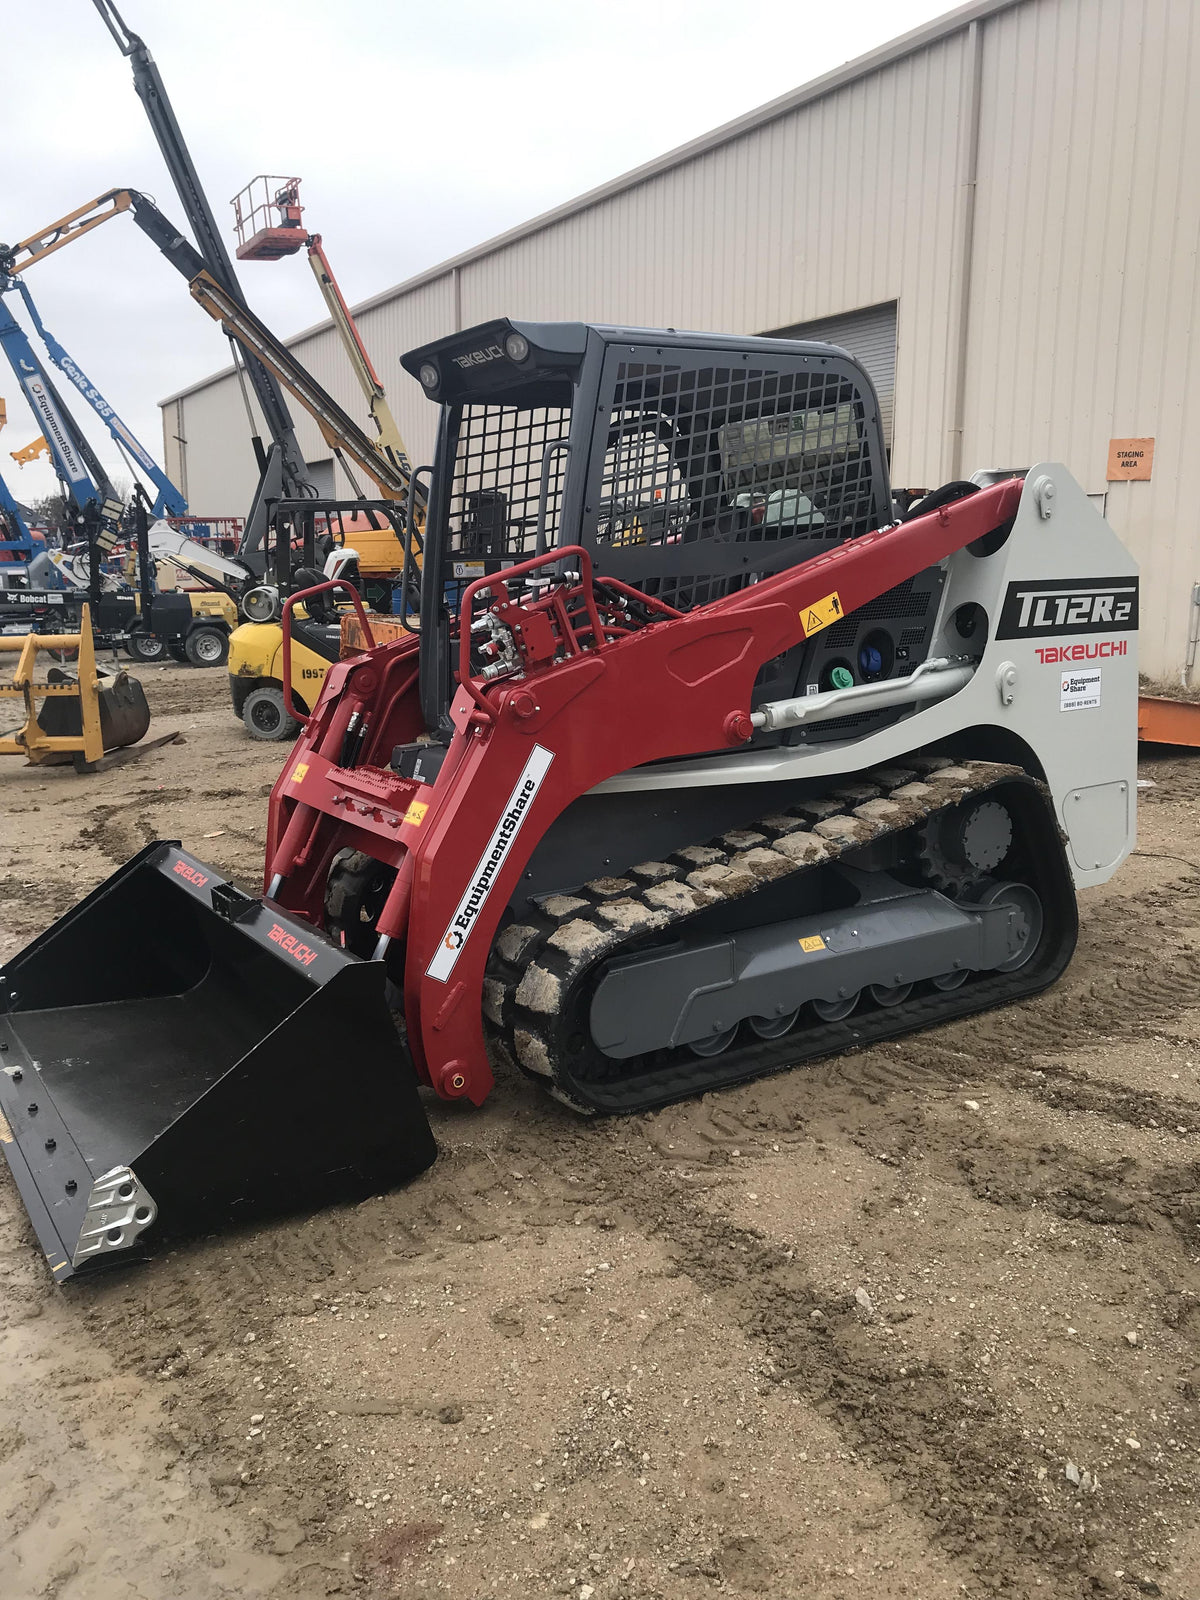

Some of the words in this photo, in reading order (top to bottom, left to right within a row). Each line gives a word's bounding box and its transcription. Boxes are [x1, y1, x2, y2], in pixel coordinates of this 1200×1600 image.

[61, 357, 88, 389] Genie
[86, 388, 114, 417] S-65
[38, 394, 79, 473] EquipmentShare
[20, 594, 47, 604] Bobcat
[1016, 587, 1136, 628] TL12R2
[302, 668, 325, 679] 1997
[1070, 676, 1100, 686] Equipment
[455, 778, 536, 930] EquipmentShare
